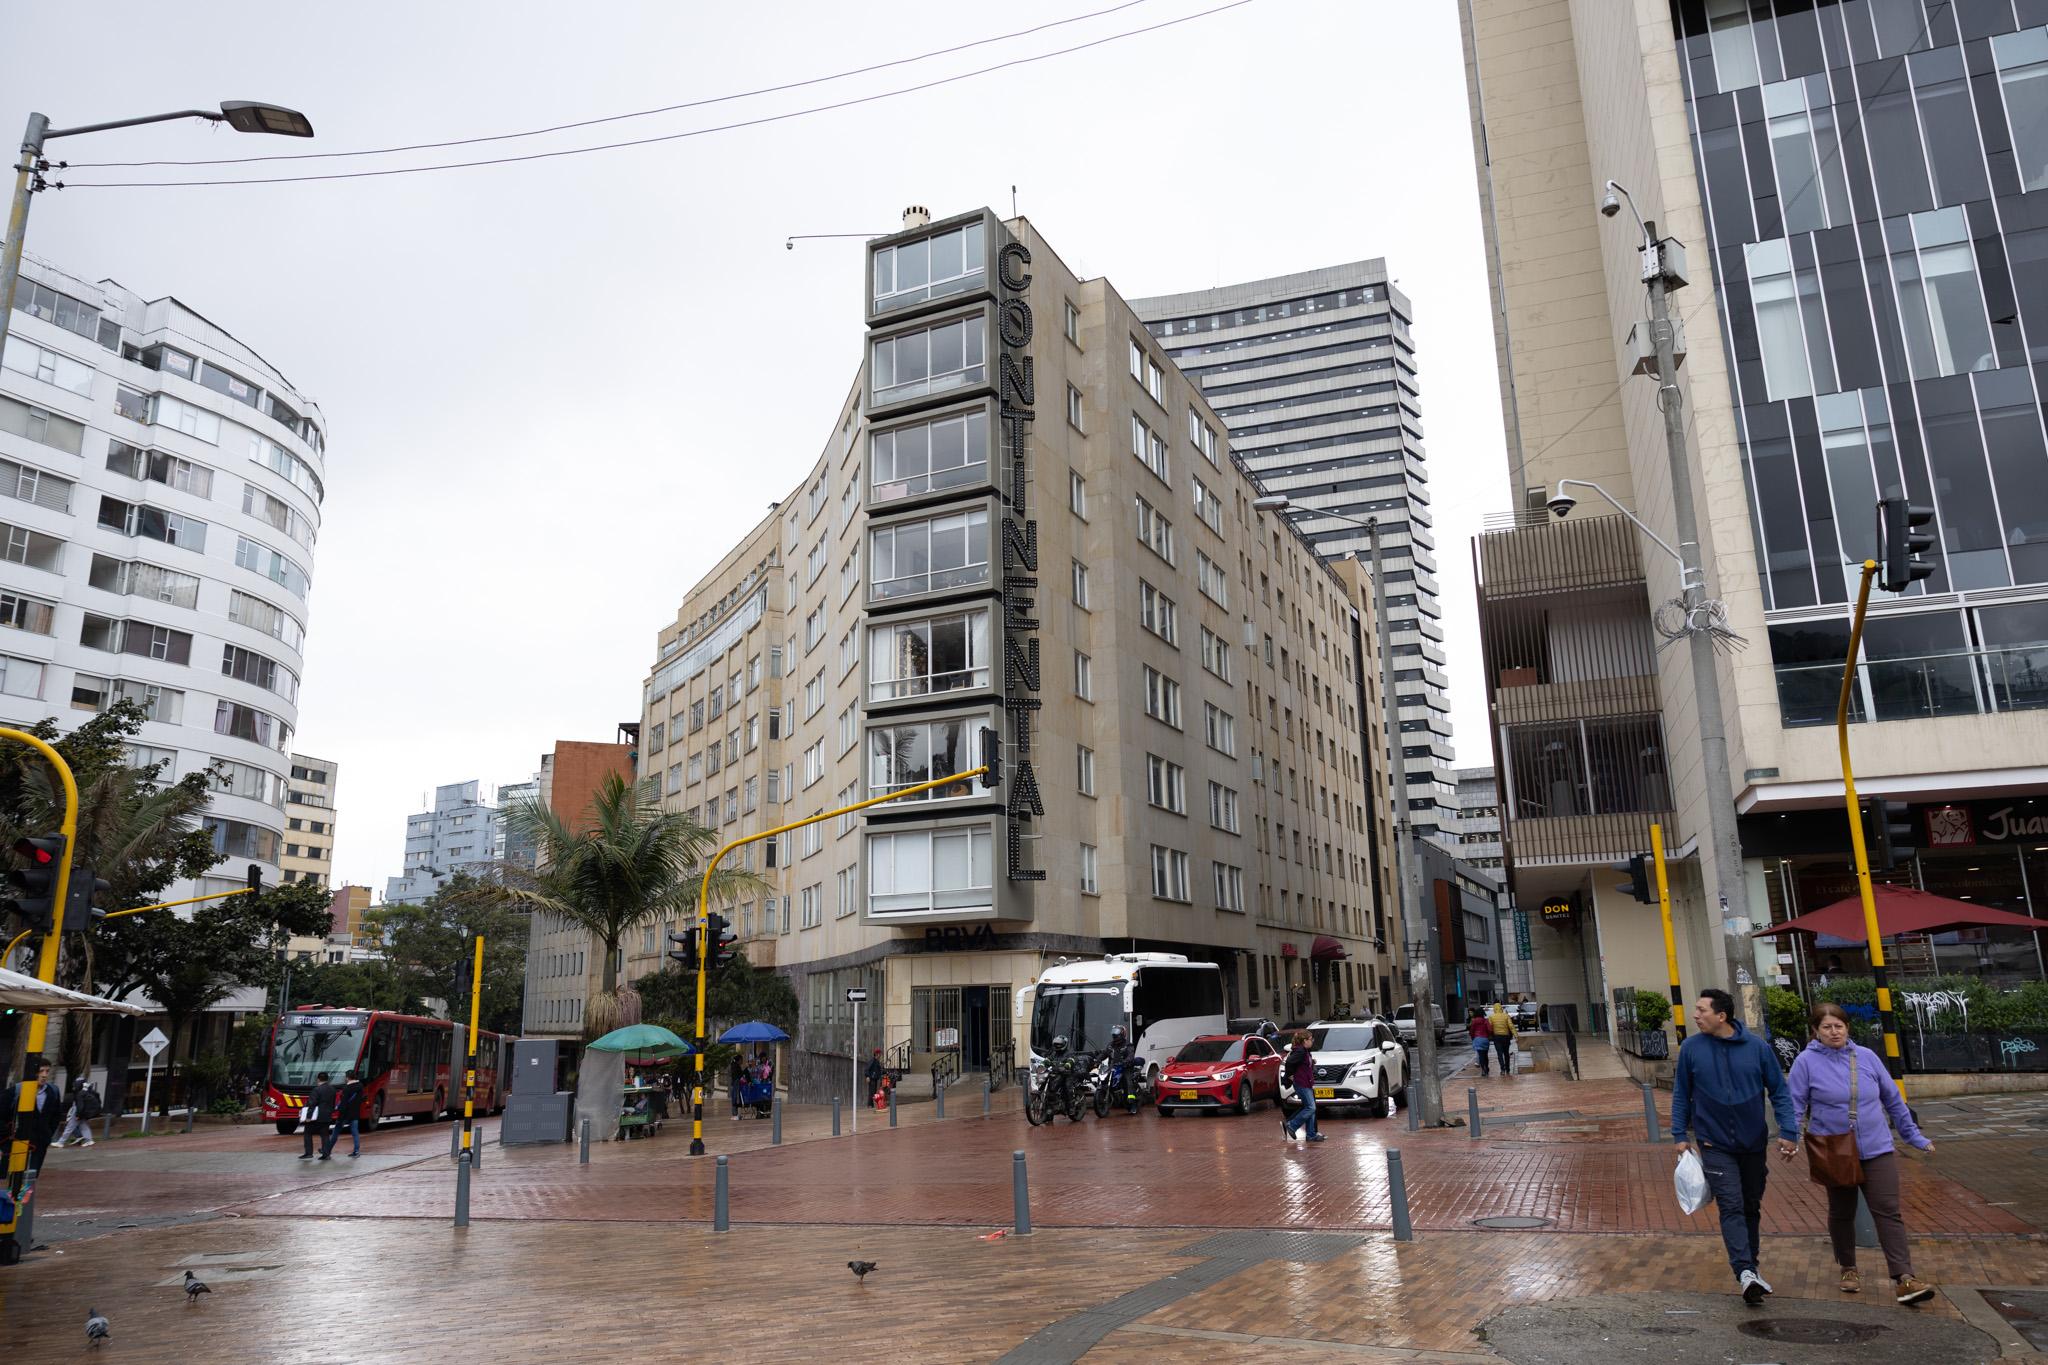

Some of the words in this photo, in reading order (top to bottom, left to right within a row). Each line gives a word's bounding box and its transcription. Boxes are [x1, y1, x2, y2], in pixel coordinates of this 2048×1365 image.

[999, 242, 1046, 880] CONTINENTAL
[1521, 911, 1529, 943] UBLICO
[1544, 904, 1569, 914] DON
[1514, 908, 1525, 960] ARQUEADERO
